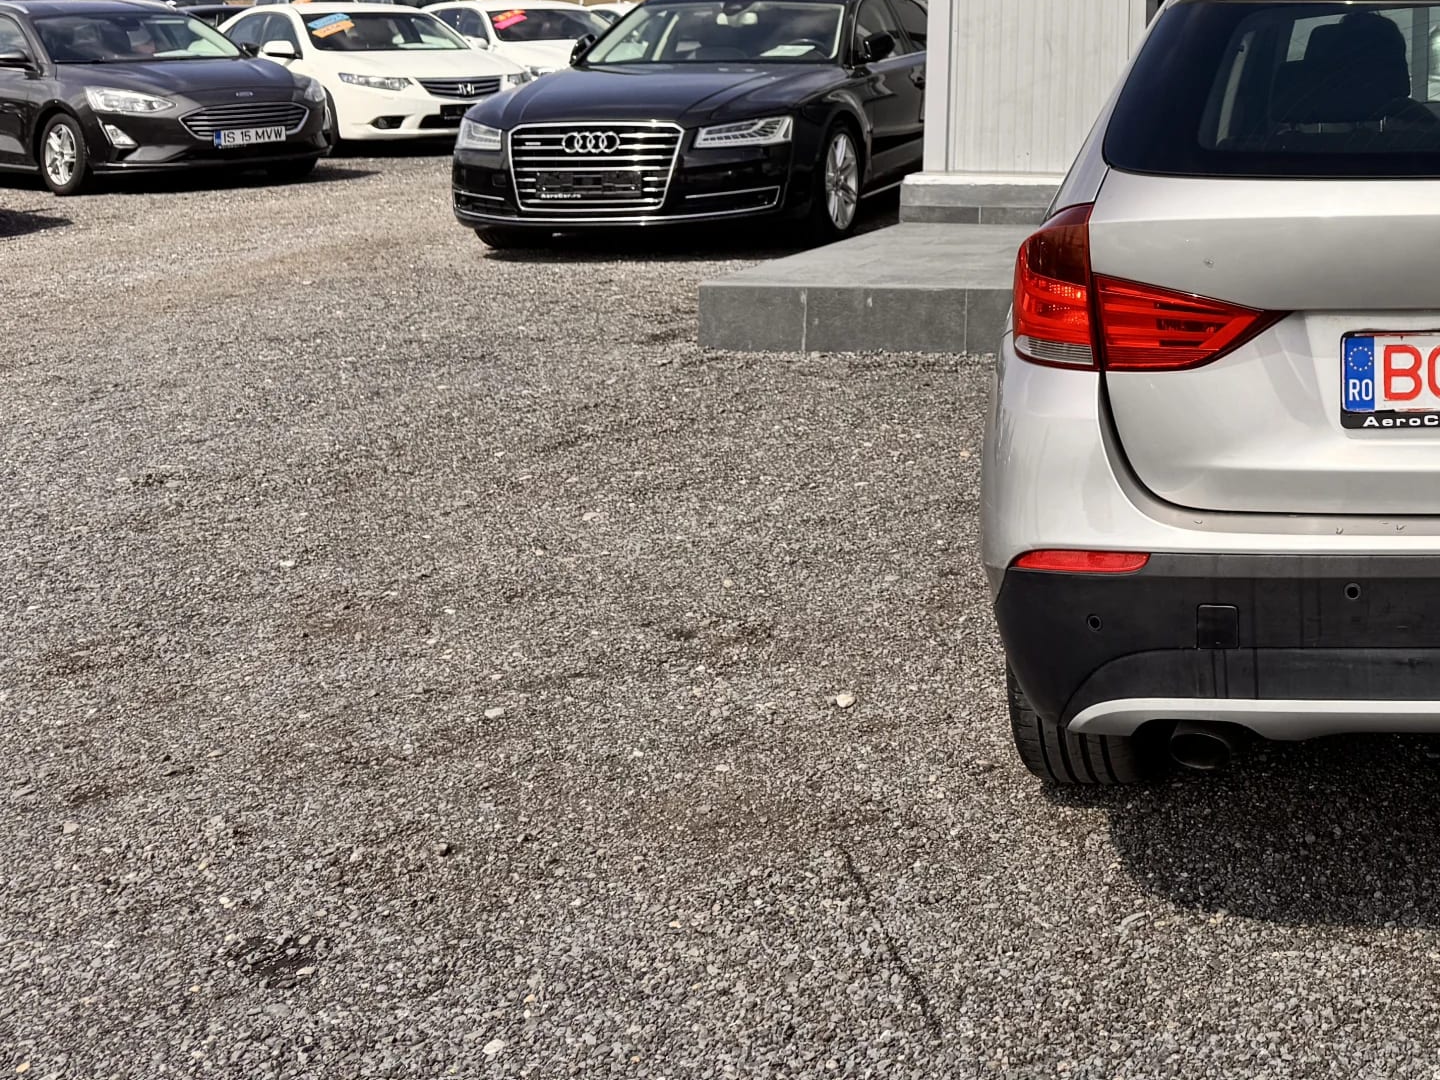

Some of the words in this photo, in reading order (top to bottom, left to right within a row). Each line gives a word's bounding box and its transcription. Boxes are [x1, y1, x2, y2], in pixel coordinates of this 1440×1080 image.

[223, 131, 236, 144] IS
[240, 130, 252, 142] 15
[255, 127, 283, 141] MVW
[1349, 379, 1373, 401] RO
